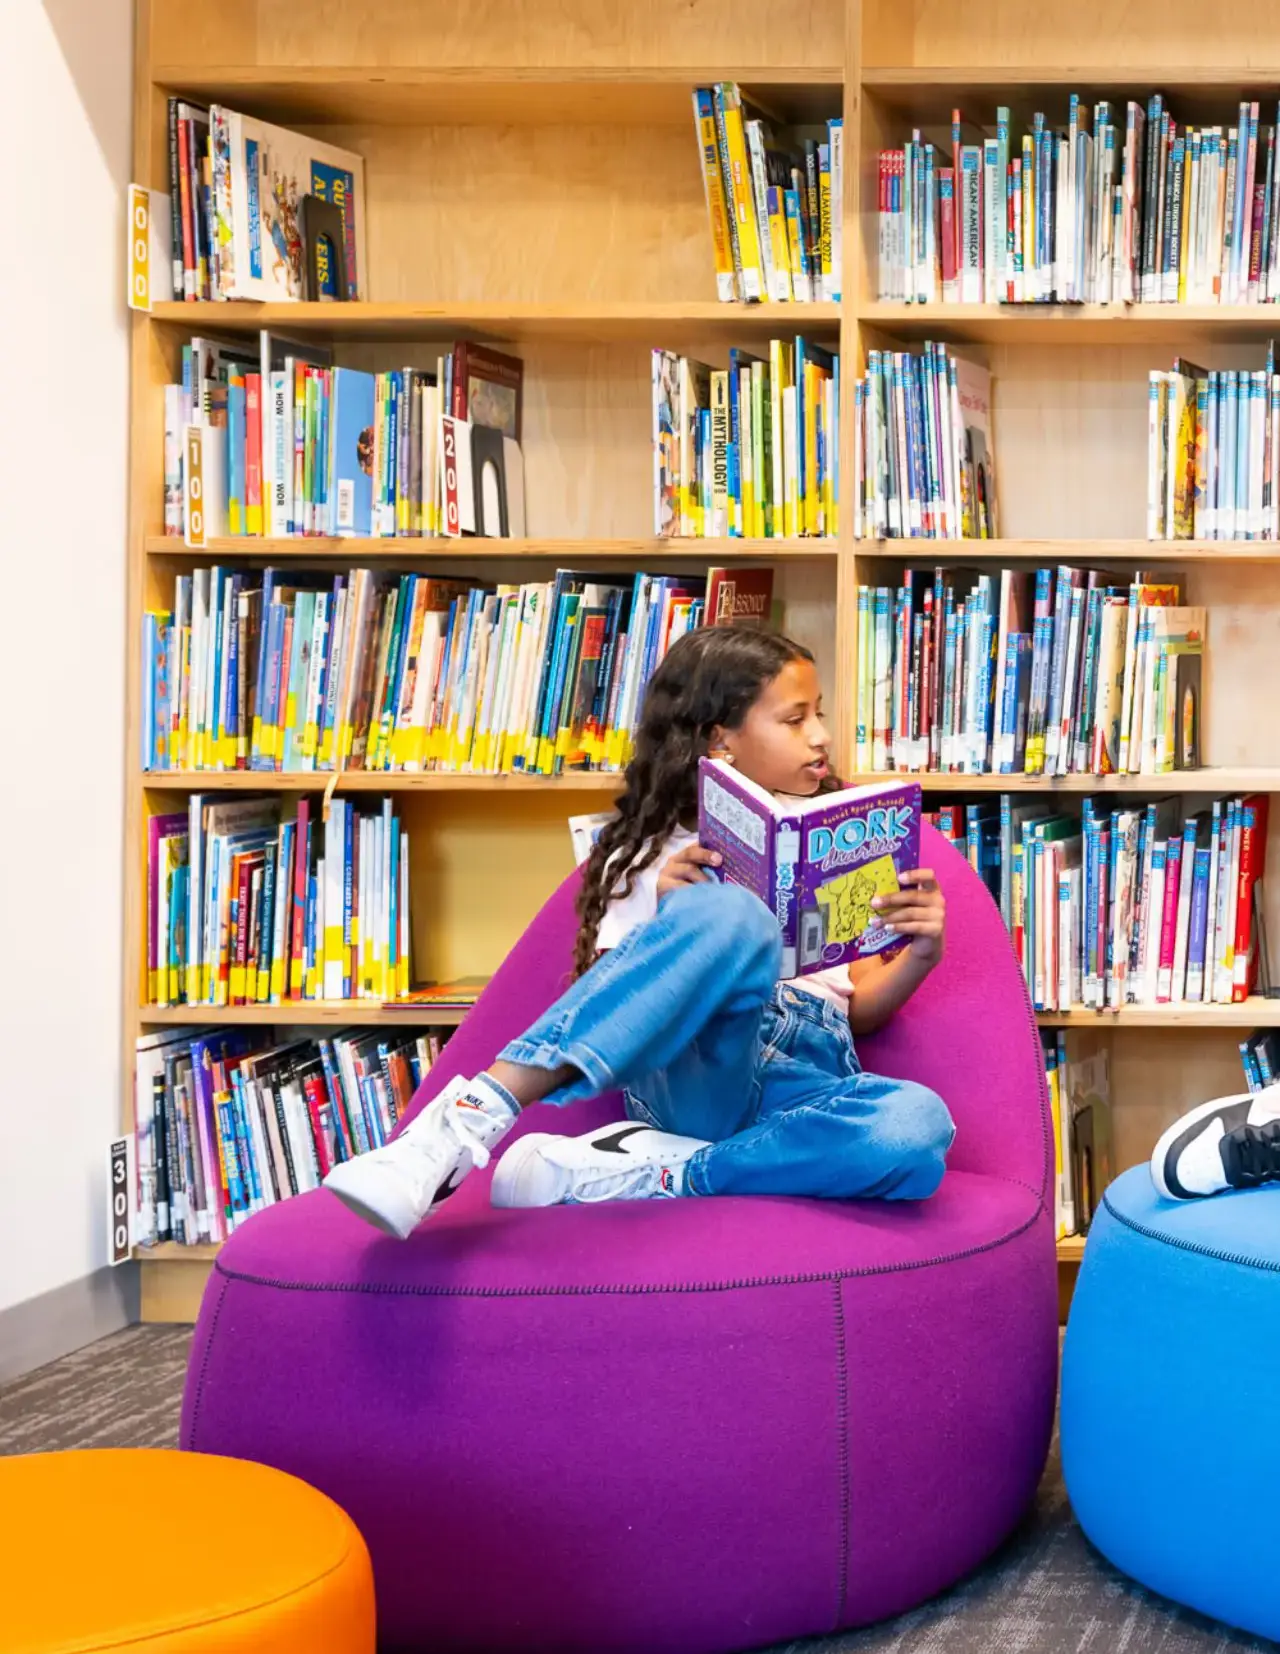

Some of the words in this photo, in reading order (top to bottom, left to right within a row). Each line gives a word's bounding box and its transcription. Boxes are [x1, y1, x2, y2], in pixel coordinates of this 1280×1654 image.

[822, 185, 832, 238] ALMANAC
[276, 393, 285, 415] HOW
[714, 416, 727, 487] MYTHOLOGY
[190, 441, 204, 533] 100
[276, 483, 285, 506] WOR
[444, 433, 459, 526] 200
[808, 806, 913, 864] DORK
[821, 839, 902, 872] diaries
[464, 1094, 485, 1107] NIKE
[114, 1160, 127, 1249] 300
